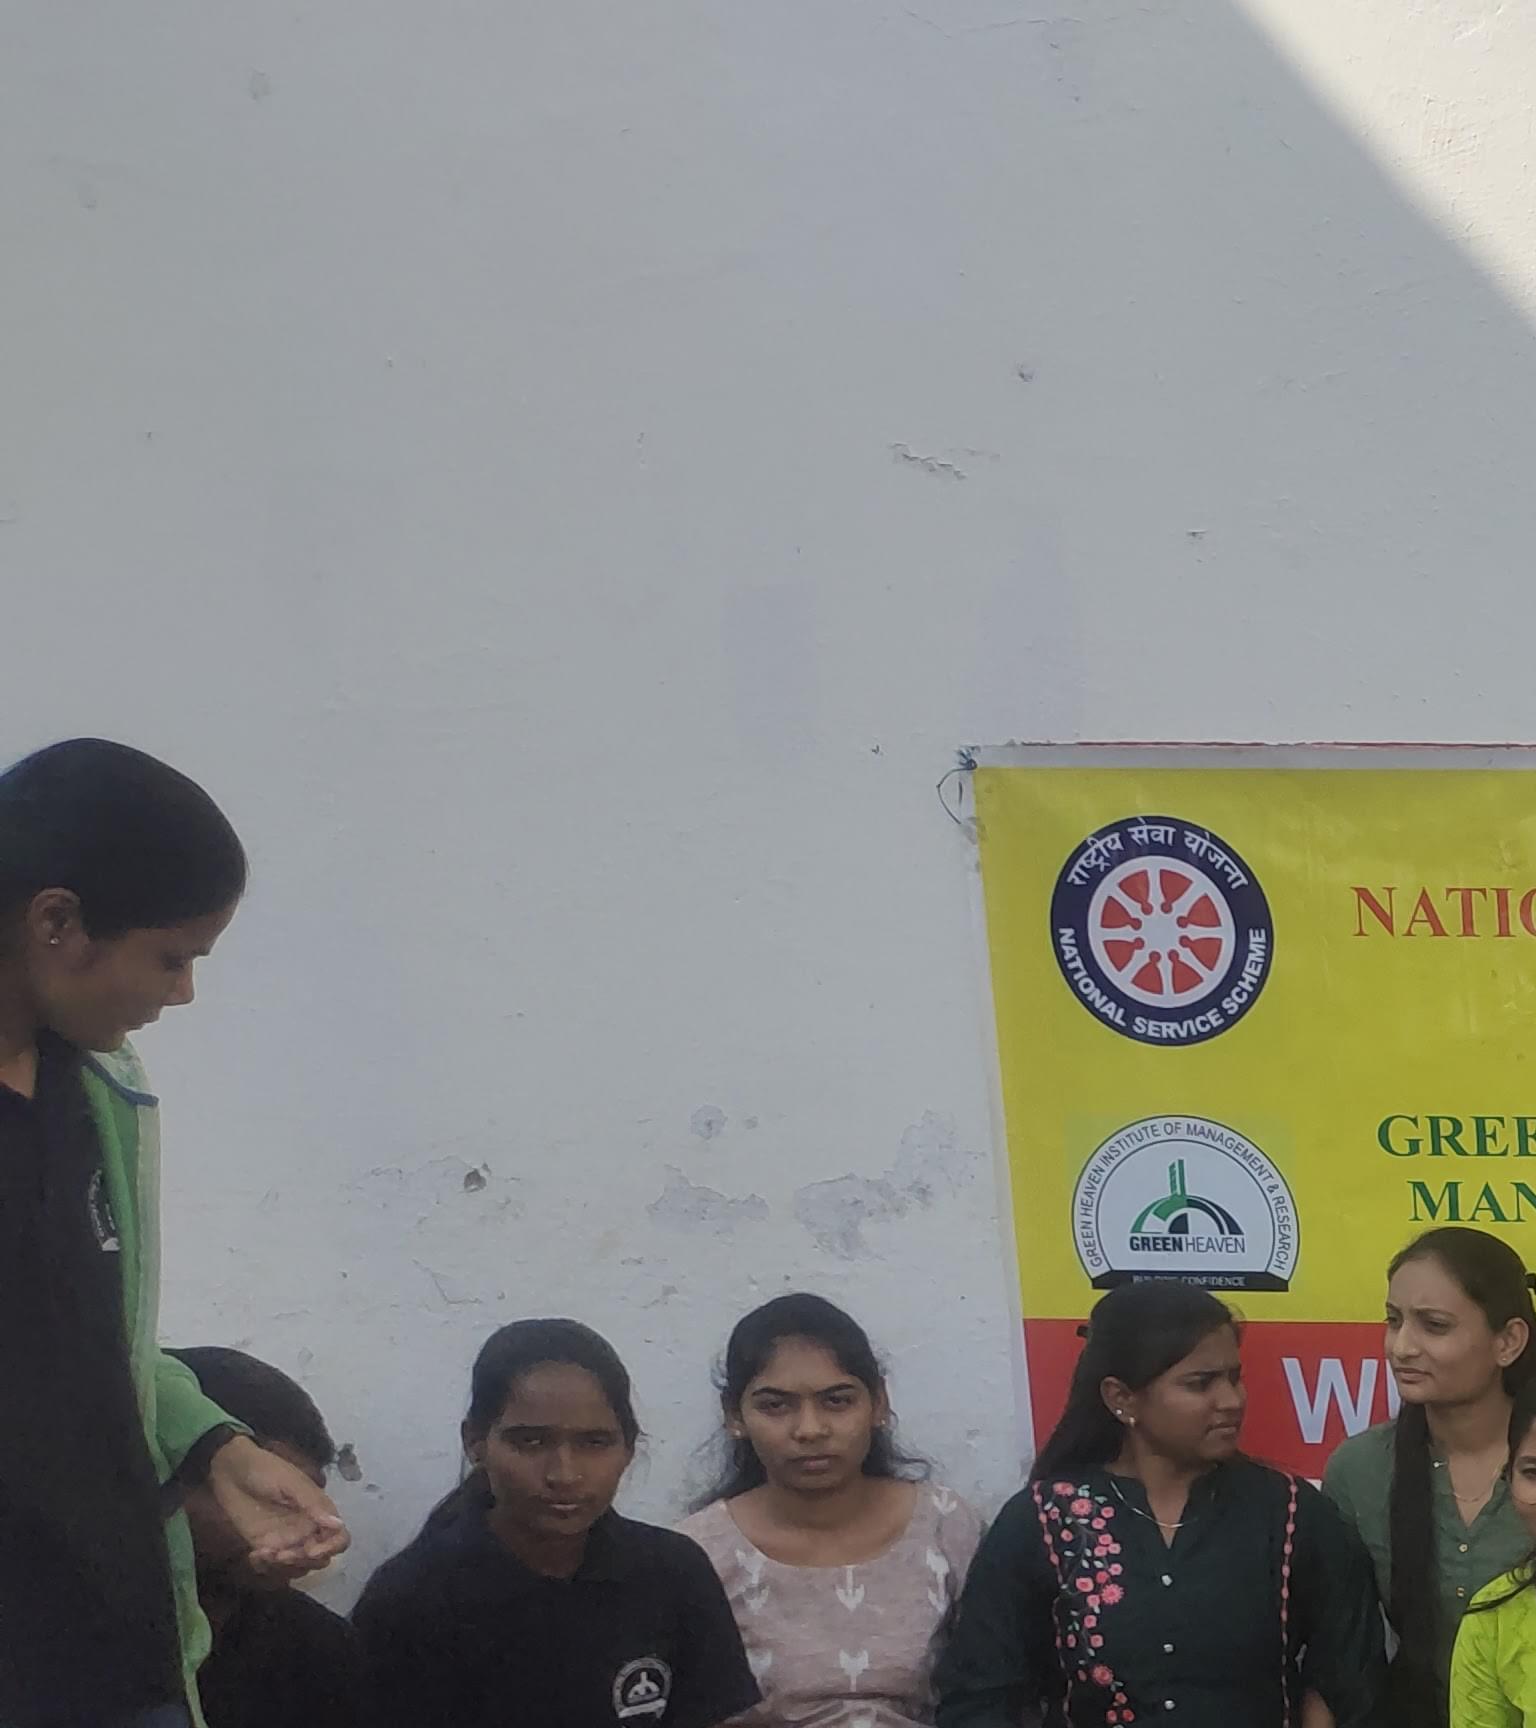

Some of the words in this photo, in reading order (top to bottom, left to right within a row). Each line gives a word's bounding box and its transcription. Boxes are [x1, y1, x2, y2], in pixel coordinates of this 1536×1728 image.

[1067, 832, 1124, 885] राष्ट्रीय
[1128, 817, 1176, 847] सेवा
[1184, 831, 1248, 890] योजना
[1059, 928, 1127, 1027] NATIONAL
[1133, 1008, 1224, 1039] SERVICE
[1221, 928, 1266, 1015] SCHEME
[1101, 1123, 1160, 1168] INSTITUTE
[1164, 1122, 1182, 1136] OF
[1186, 1122, 1274, 1183] MANAGEMENT
[1080, 1167, 1104, 1217] HEAVEN
[1267, 1183, 1280, 1194] &
[1080, 1220, 1102, 1268] GREEN
[1272, 1196, 1292, 1271] RESEARCH
